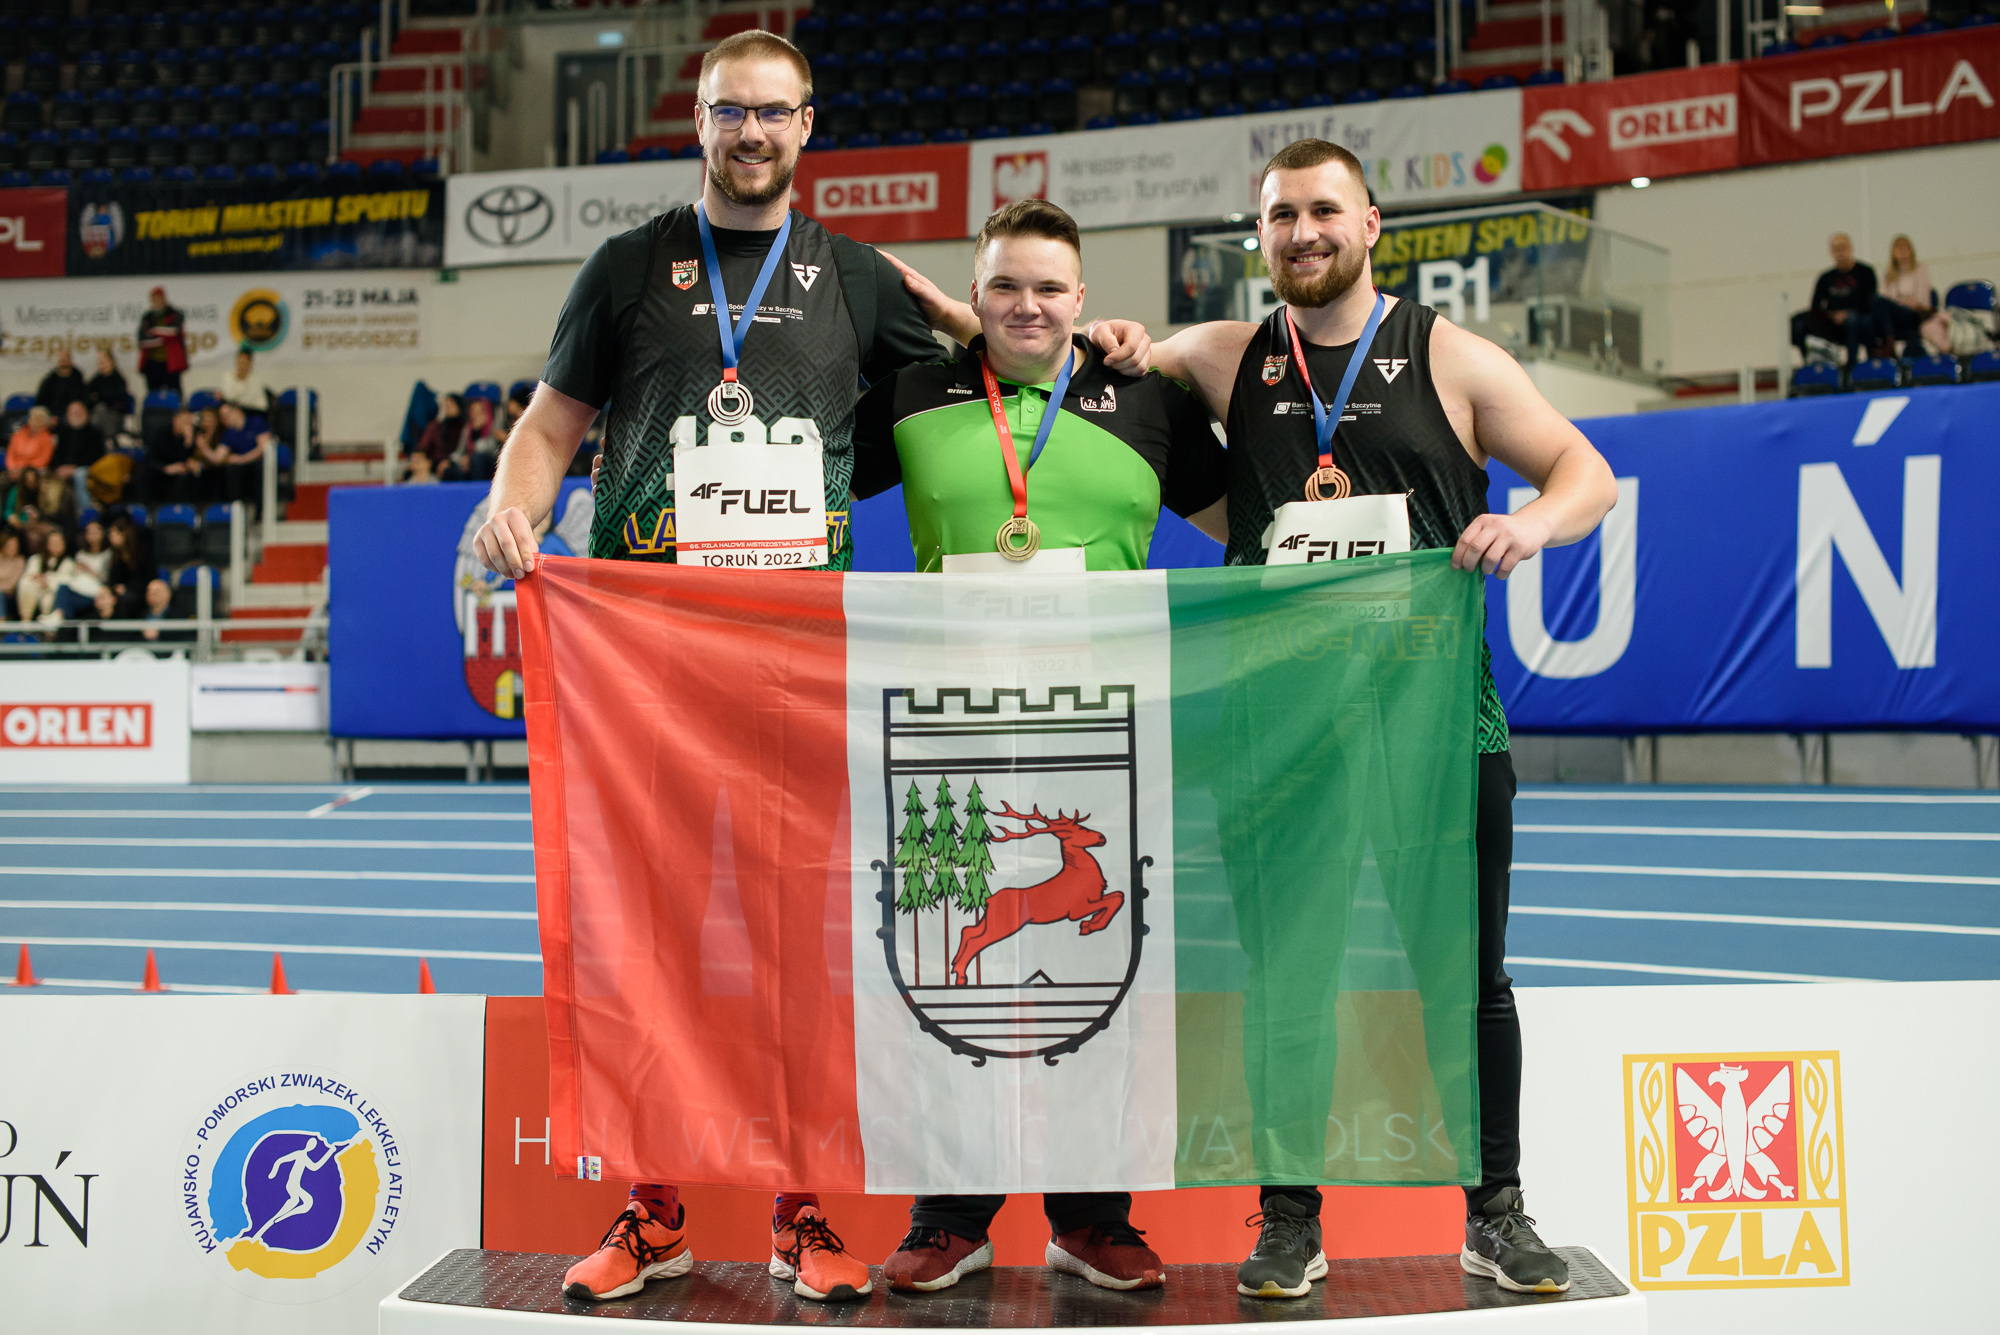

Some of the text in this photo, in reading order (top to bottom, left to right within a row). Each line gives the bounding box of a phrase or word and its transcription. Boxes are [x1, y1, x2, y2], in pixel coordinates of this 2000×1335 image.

[1790, 60, 1995, 132] PZLA
[1617, 104, 1728, 140] ORLEN
[1404, 151, 1466, 191] KIDS
[821, 176, 932, 210] ORLEN
[1373, 222, 1473, 268] ASTEM
[1418, 256, 1490, 323] R1
[946, 387, 973, 396] erima
[690, 482, 812, 515] 4F FUEL
[702, 550, 803, 568] TORUŃ 2022
[1278, 533, 1311, 550] 4F
[3, 706, 145, 746] ORLEN
[280, 1072, 359, 1105] ZWIĄZEK
[196, 1076, 277, 1142] POMORSKI
[356, 1100, 402, 1168] LEKKIEJ
[184, 1153, 217, 1255] KUJAWSKO
[365, 1171, 403, 1256] ATLETYKI
[1640, 1209, 1839, 1279] PZLA
